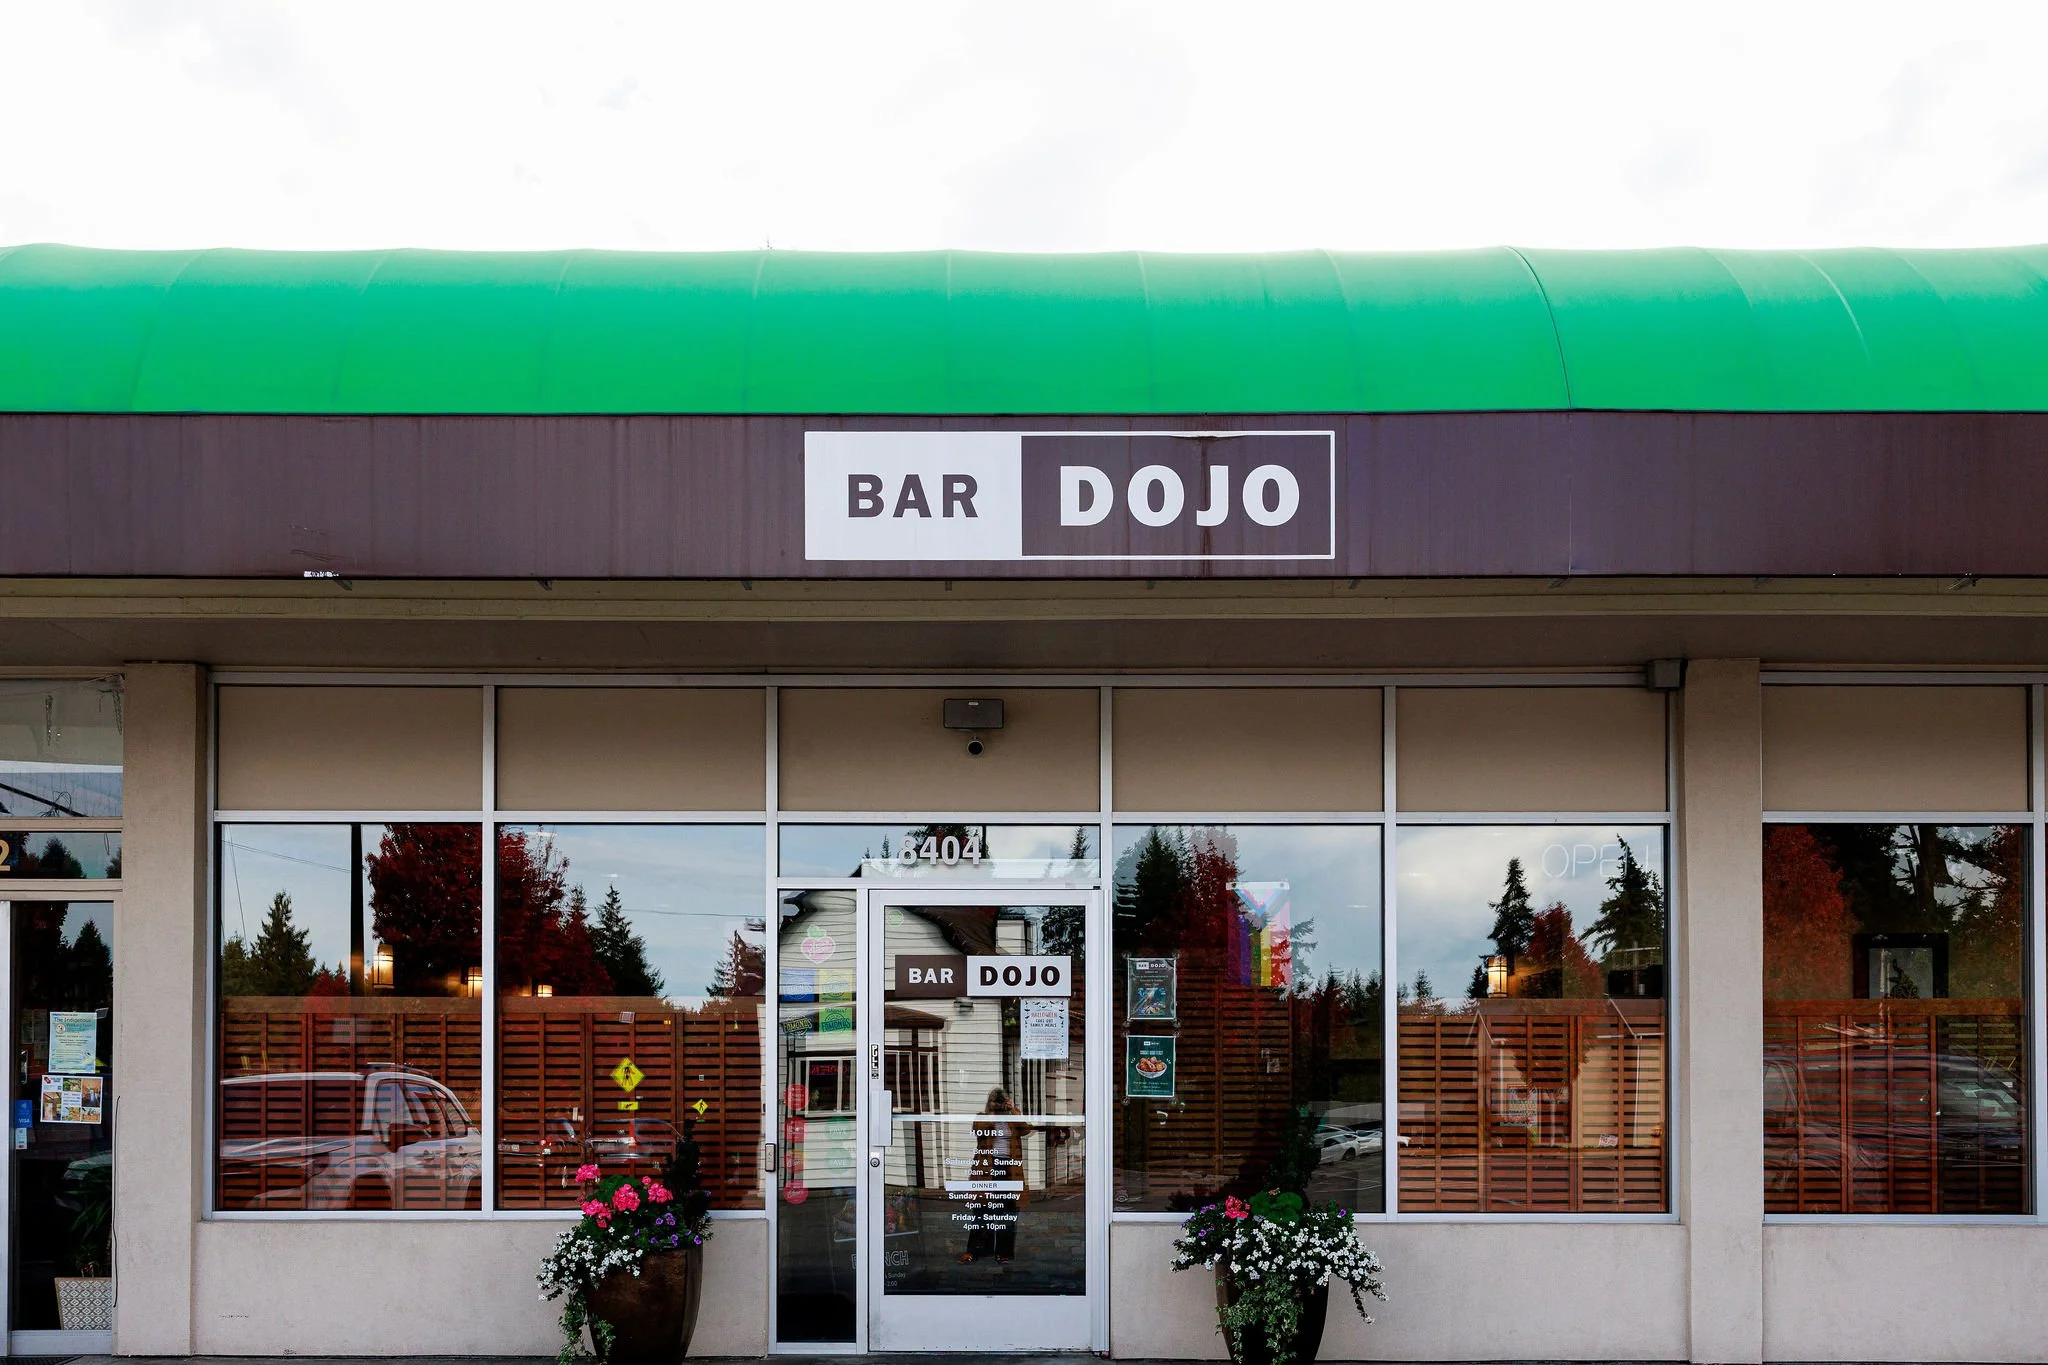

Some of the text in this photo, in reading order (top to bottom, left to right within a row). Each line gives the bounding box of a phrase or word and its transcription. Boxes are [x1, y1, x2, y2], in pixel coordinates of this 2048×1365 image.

[847, 464, 1300, 527] BAR DOJO
[898, 835, 982, 866] 8404
[908, 965, 1061, 987] BAR DOJO
[969, 1129, 1004, 1137] HOURS
[945, 1158, 980, 1167] Saturday
[993, 1158, 1023, 1167] Sunday
[990, 1169, 1007, 1177] 2pm
[948, 1193, 978, 1201] Sunday
[984, 1193, 1021, 1201] Thursday
[964, 1202, 982, 1210] 4pm
[987, 1202, 1005, 1210] 9pm
[951, 1214, 976, 1222] Friday
[982, 1214, 1018, 1222] Saturday
[963, 1223, 980, 1231] 4pm
[986, 1223, 1007, 1231] 10pm
